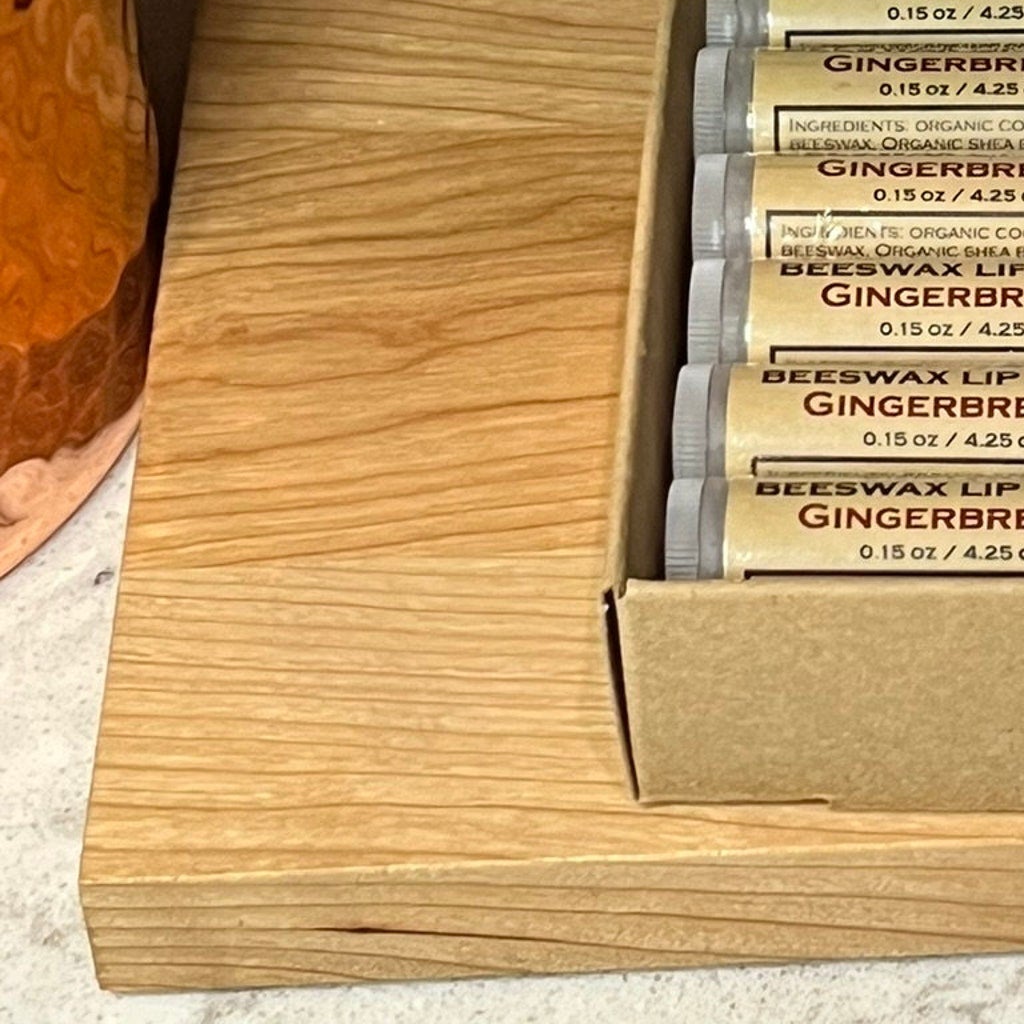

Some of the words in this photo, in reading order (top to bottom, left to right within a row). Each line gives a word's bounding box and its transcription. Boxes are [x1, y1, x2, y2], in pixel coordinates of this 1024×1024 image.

[887, 6, 928, 20] 0.15
[962, 6, 974, 20] /
[979, 6, 1024, 20] 4.25
[879, 82, 921, 96] 0.15
[956, 82, 967, 96] /
[973, 82, 1019, 96] 4.25
[915, 119, 993, 132] ORGANIC
[881, 137, 962, 150] ORGANIC
[968, 138, 1014, 150] SHEA
[873, 188, 915, 202] 0.15
[952, 188, 964, 202] /
[970, 188, 1017, 202] 4.25
[909, 227, 990, 240] ORGANIC
[875, 243, 959, 258] ORGANIC
[964, 245, 1010, 258] SHEA
[779, 263, 965, 276] BEESWAX
[879, 321, 923, 336] 0.15
[959, 321, 972, 336] /
[761, 370, 949, 385] BEESWAX
[962, 370, 1019, 385] LIP
[863, 431, 906, 446] 0.15
[944, 431, 957, 447] /
[964, 432, 1013, 447] 4.25
[755, 481, 948, 496] BEESWAX
[961, 482, 1020, 497] LIP
[859, 544, 907, 559] 0.15
[944, 544, 957, 560] /
[963, 545, 1013, 560] 4.25
